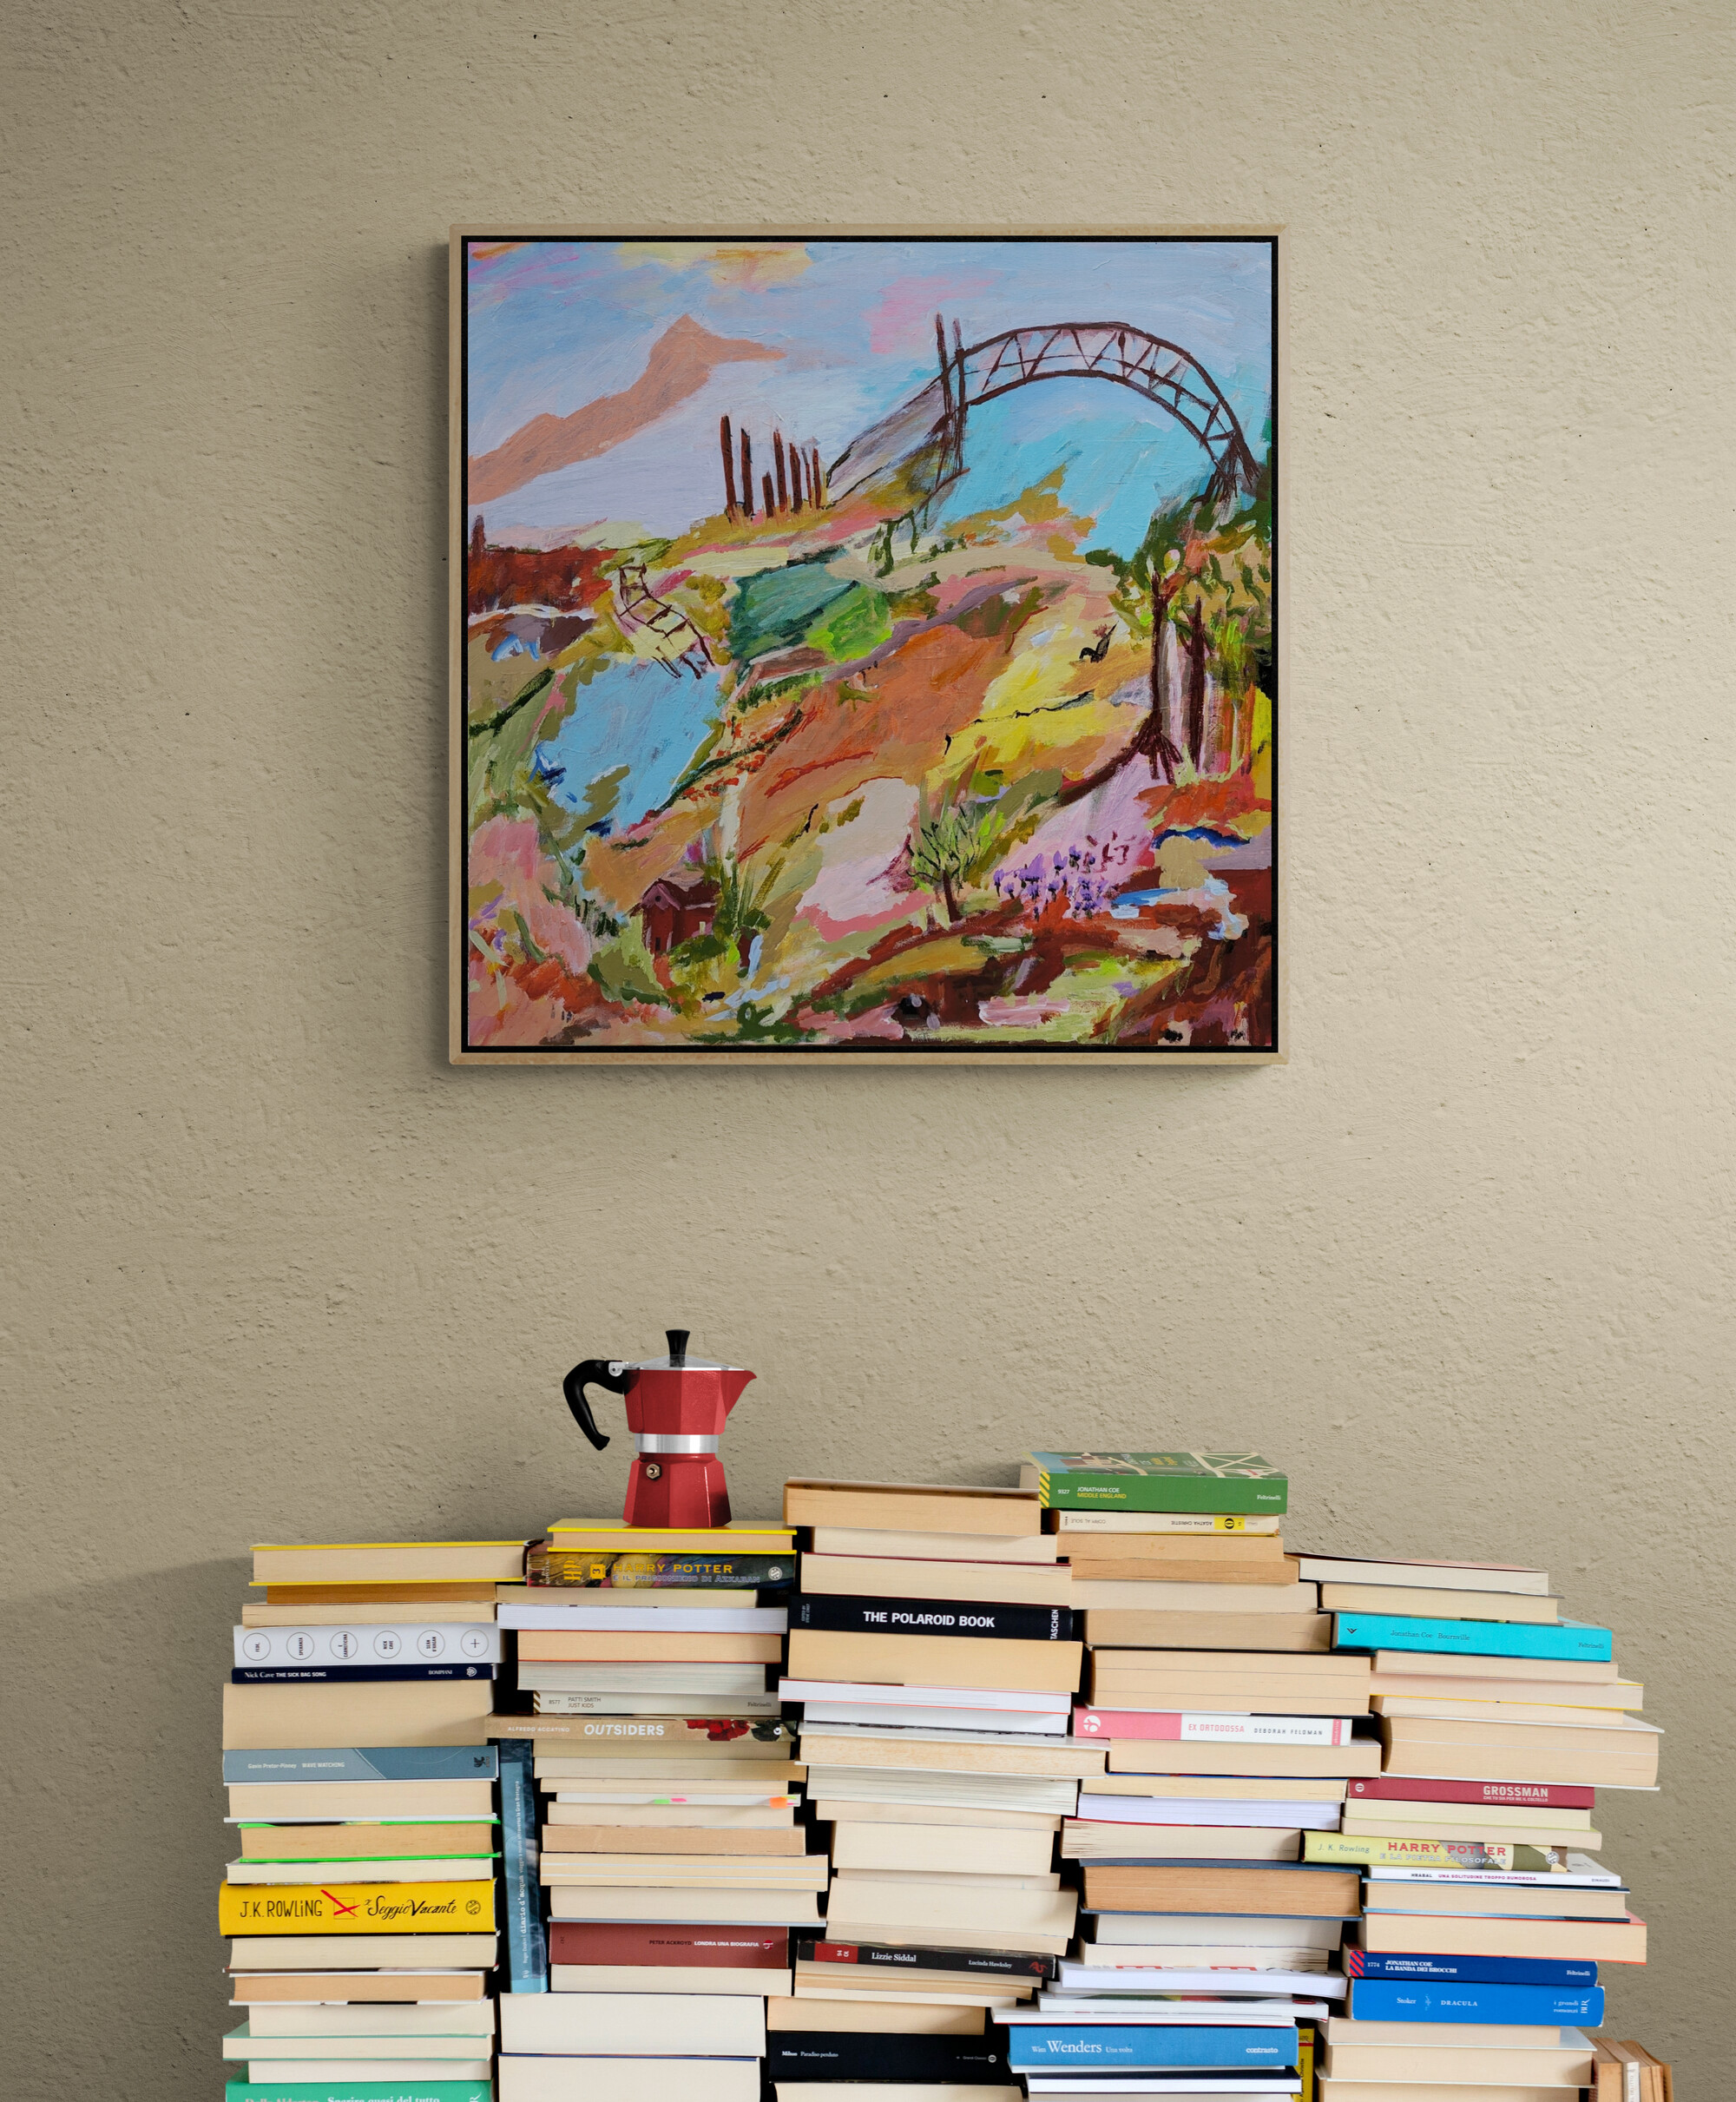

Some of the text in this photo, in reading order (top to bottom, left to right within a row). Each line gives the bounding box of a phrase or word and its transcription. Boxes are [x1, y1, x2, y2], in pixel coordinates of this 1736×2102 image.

[613, 1563, 733, 1573] HARRY POTTER
[863, 1611, 996, 1628] THE POLAROID BOOK
[1050, 1609, 1059, 1640] TASCHEN
[584, 1723, 665, 1736] OUTSIDERS
[1200, 1723, 1245, 1733] ORTODOSSA
[1483, 1785, 1549, 1797] GROSSMAN
[1338, 1844, 1370, 1854] Rowling
[1388, 1842, 1507, 1856] HARRY POTTER
[1406, 1854, 1441, 1862] PIETRA
[1444, 1856, 1507, 1865] FILOSOFALE
[517, 1875, 527, 1906] d'acqua
[367, 1895, 412, 1920] Seggio
[406, 1899, 457, 1916] Vacante
[518, 1908, 528, 1934] diario
[871, 1952, 917, 1962] Lizzie Siddal
[1047, 2039, 1102, 2053] Wenders
